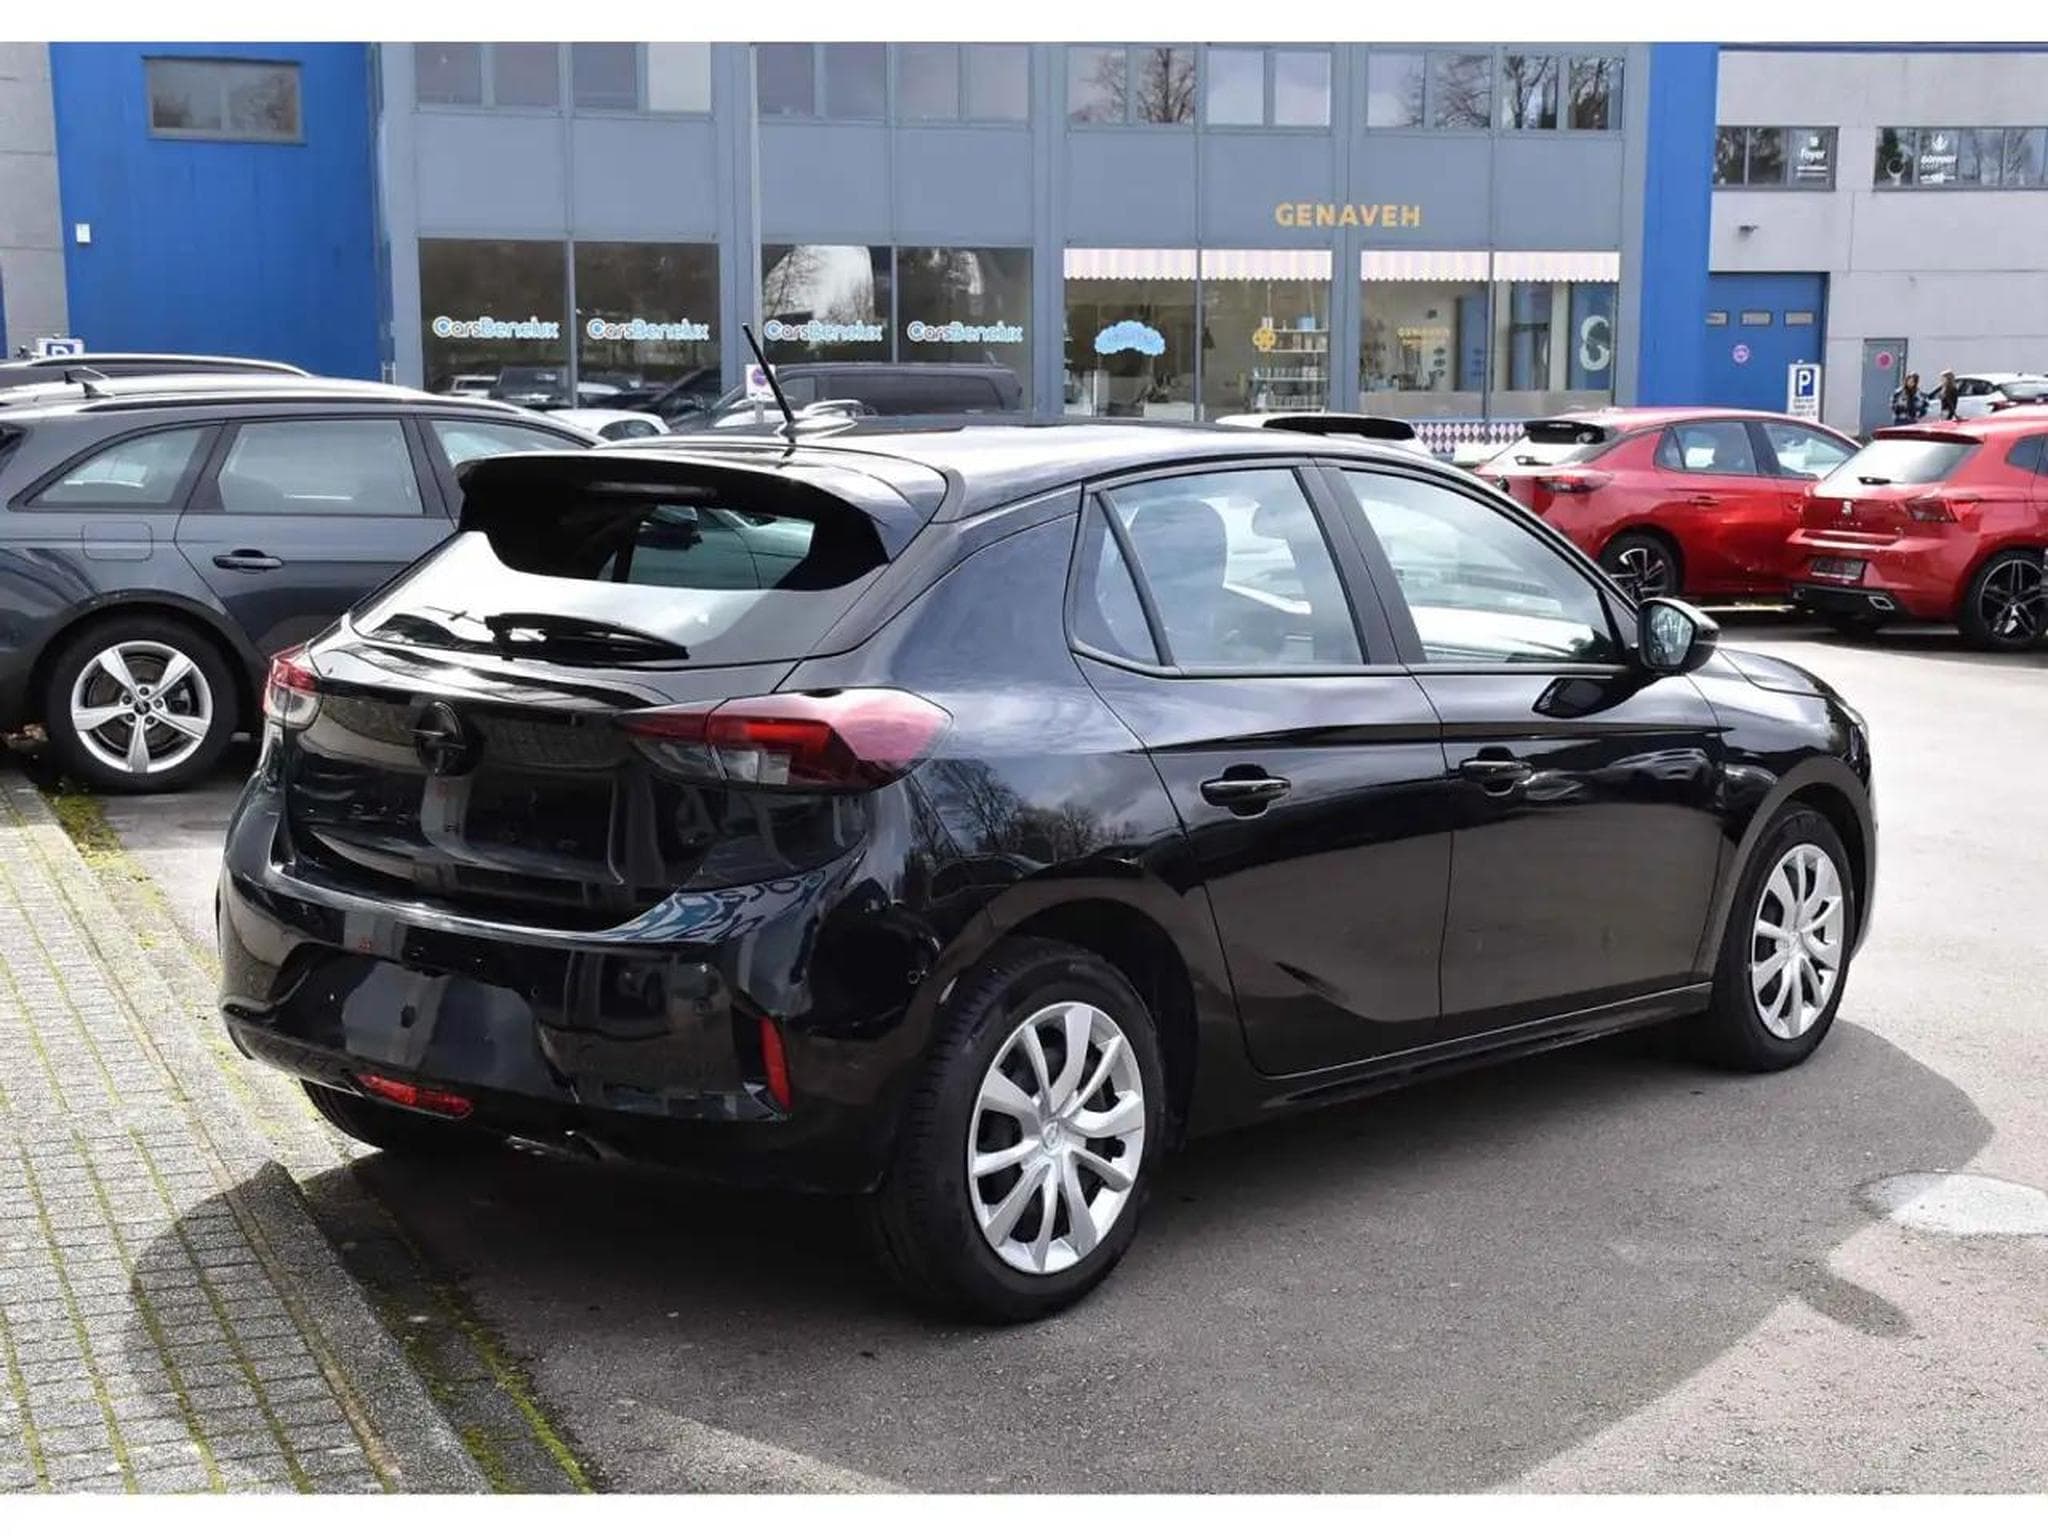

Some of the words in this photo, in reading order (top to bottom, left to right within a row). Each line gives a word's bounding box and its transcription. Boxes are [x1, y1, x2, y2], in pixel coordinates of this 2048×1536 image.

[1275, 203, 1421, 227] GENAVEH
[432, 315, 560, 338] CarsBenelux
[586, 317, 710, 341] CarsBenelux
[764, 320, 883, 342] CarsBenelux
[906, 320, 1024, 342] CarsBenelux
[1798, 370, 1812, 396] P
